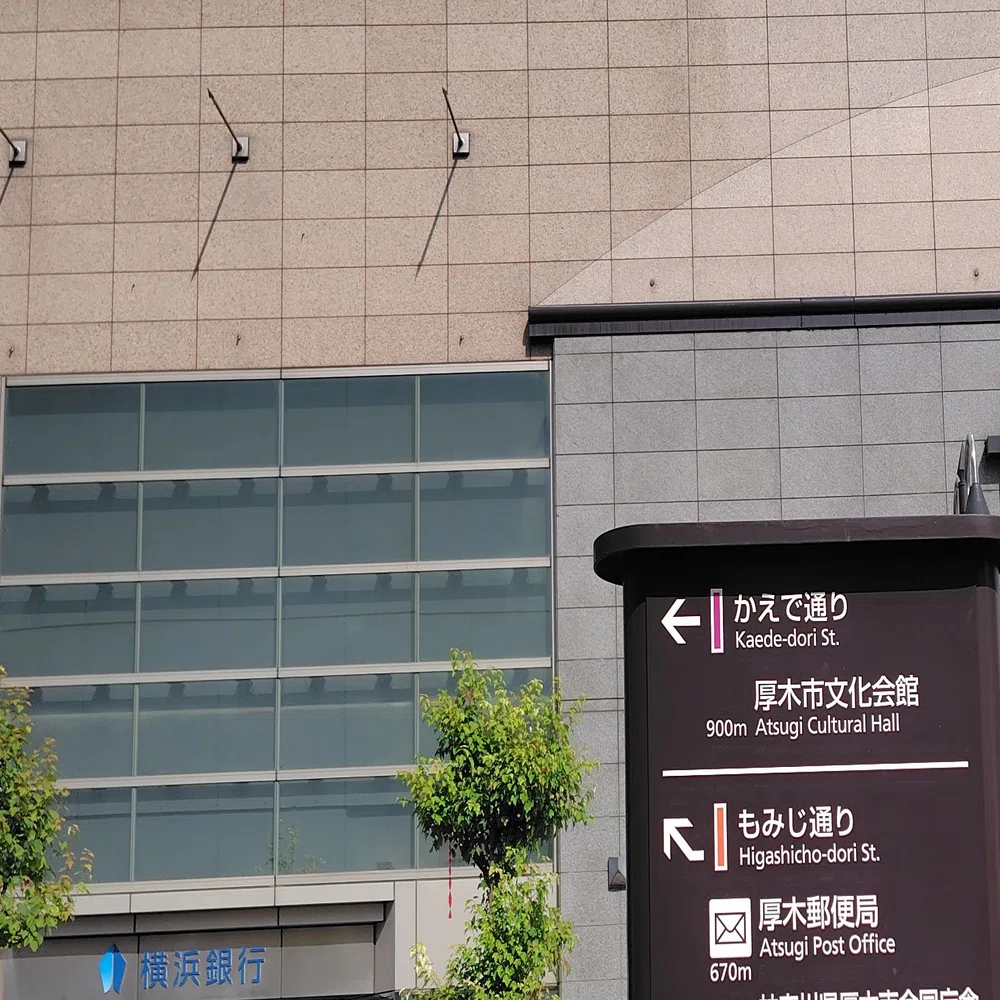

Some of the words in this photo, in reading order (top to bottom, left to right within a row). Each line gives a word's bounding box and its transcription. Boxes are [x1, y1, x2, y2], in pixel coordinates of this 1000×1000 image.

[733, 591, 848, 623] かえで通り
[735, 628, 817, 649] Kaede-dori
[821, 628, 840, 646] St.
[753, 674, 920, 712] 厚木市文化会館
[706, 719, 747, 738] 900m
[755, 715, 803, 740] Atsugi
[807, 713, 867, 735] Cultural
[871, 712, 900, 733] Hall
[738, 805, 854, 839] もみじ通り
[739, 843, 858, 871] Higashicho-dori
[861, 843, 881, 862] St.
[758, 894, 879, 932] 厚木郵便局
[759, 936, 809, 961] Atsugi
[813, 935, 846, 956] Post
[848, 932, 896, 955] Office
[141, 947, 267, 989] 横浜銀行
[709, 961, 752, 982] 670m
